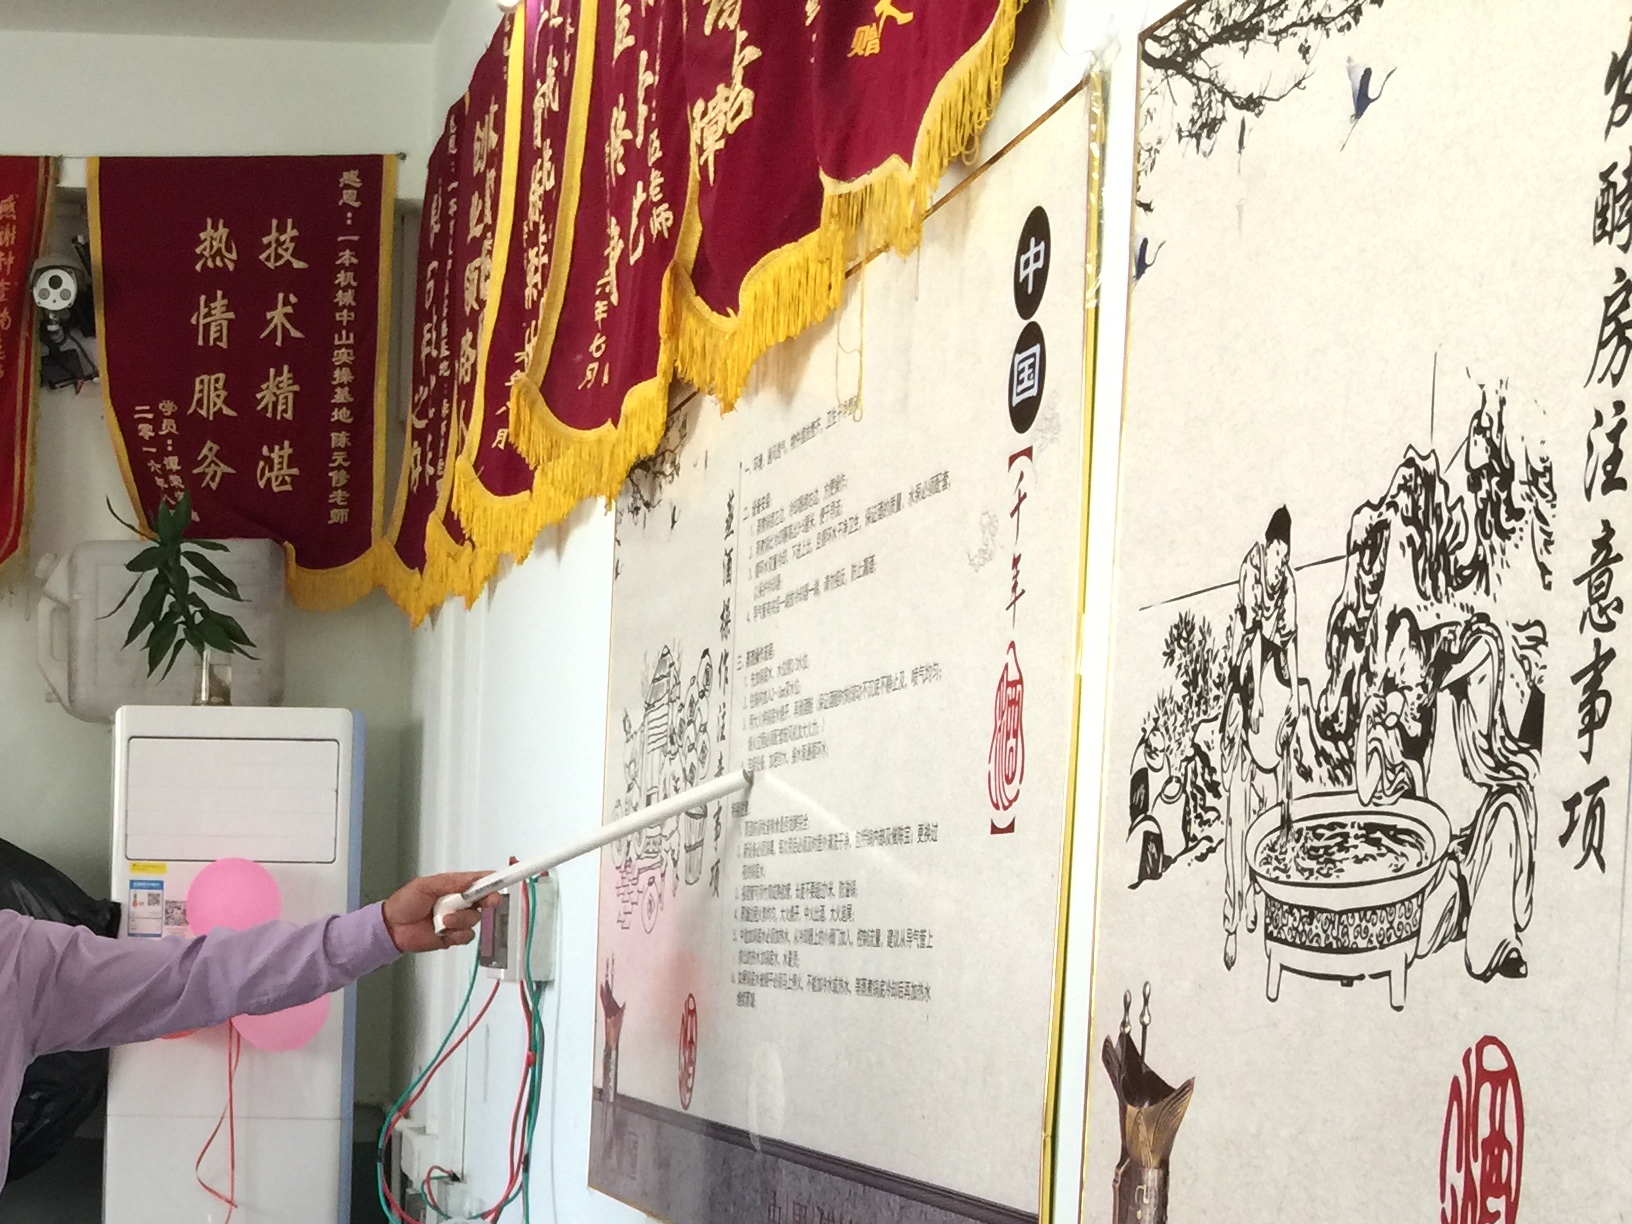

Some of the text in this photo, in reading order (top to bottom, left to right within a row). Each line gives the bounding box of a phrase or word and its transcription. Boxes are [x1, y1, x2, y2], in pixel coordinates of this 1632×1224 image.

[186, 217, 238, 491] 热情服务
[256, 217, 309, 492] 技术精湛
